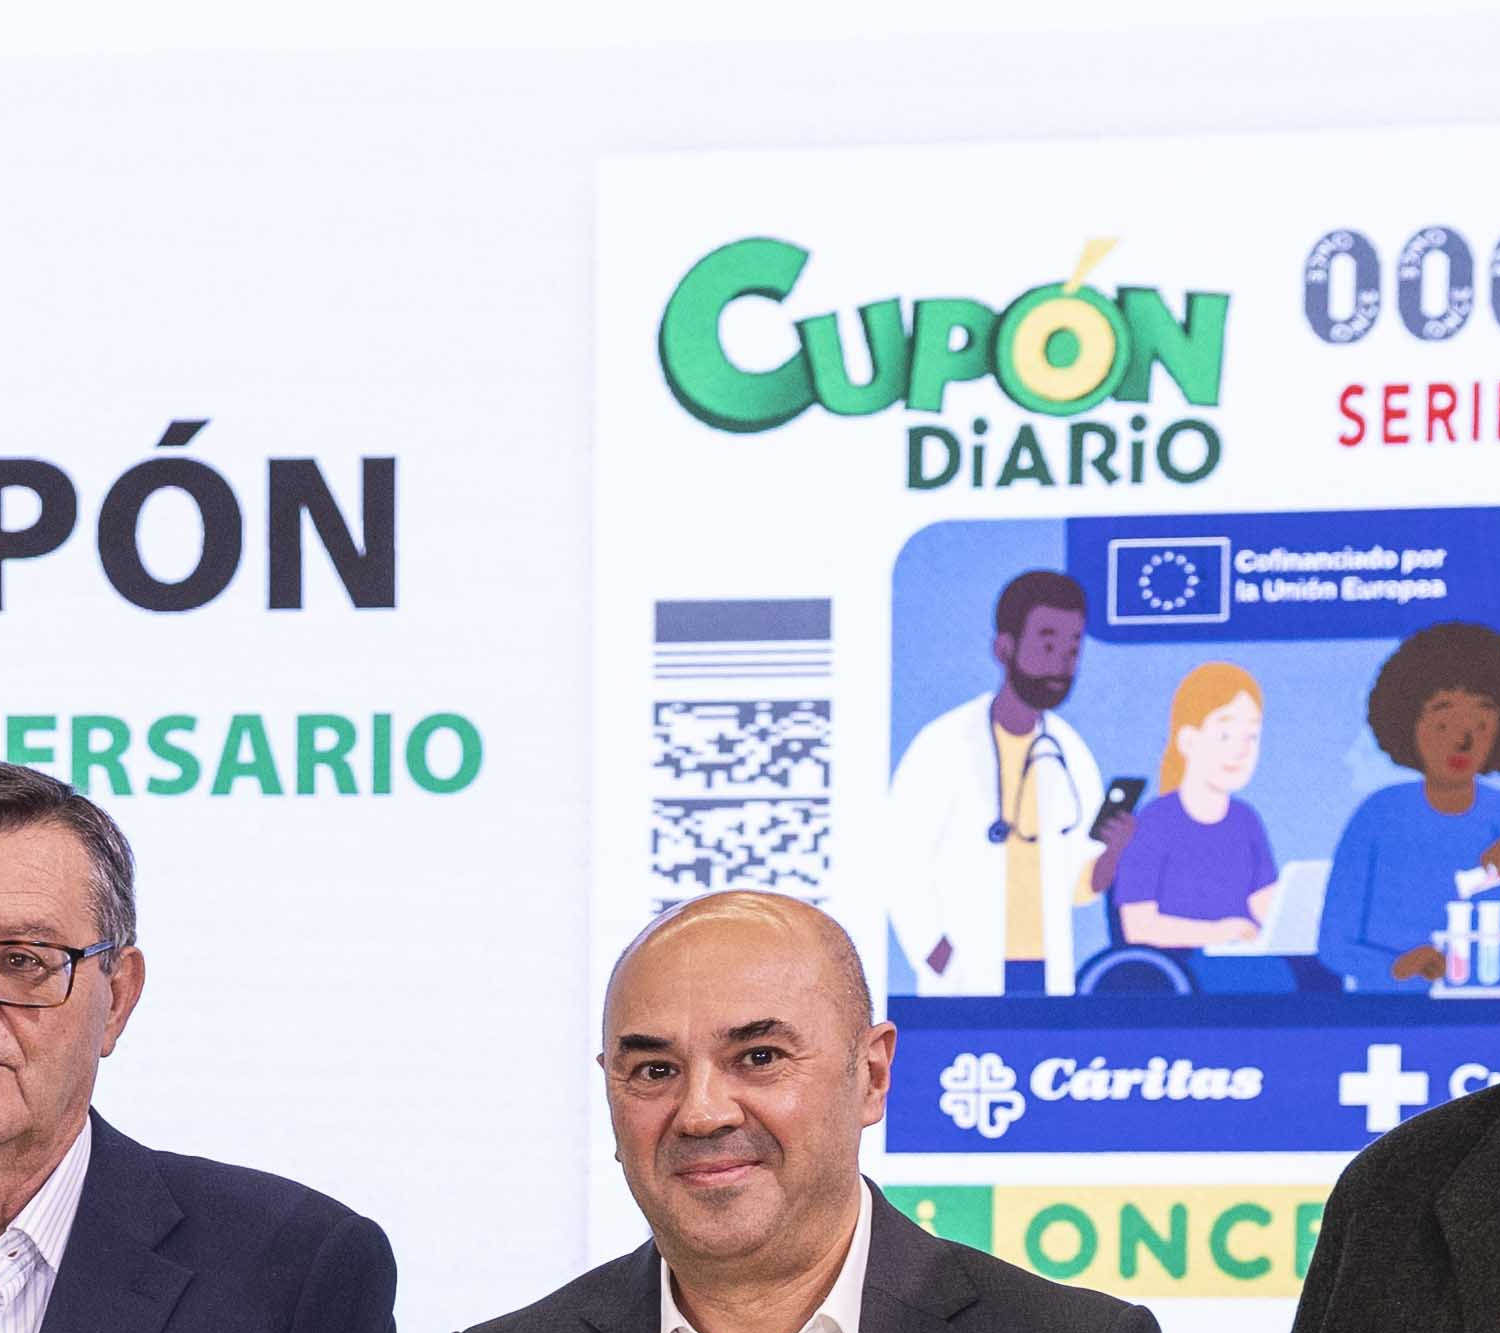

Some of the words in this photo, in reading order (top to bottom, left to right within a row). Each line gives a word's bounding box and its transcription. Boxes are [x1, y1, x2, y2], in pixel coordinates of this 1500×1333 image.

[1234, 545, 1398, 574] Cofinanciado
[1400, 549, 1447, 575] por
[1235, 578, 1260, 602] la
[1262, 576, 1338, 602] Unión
[1341, 575, 1447, 605] Europea
[1030, 1056, 1263, 1101] Cáritas
